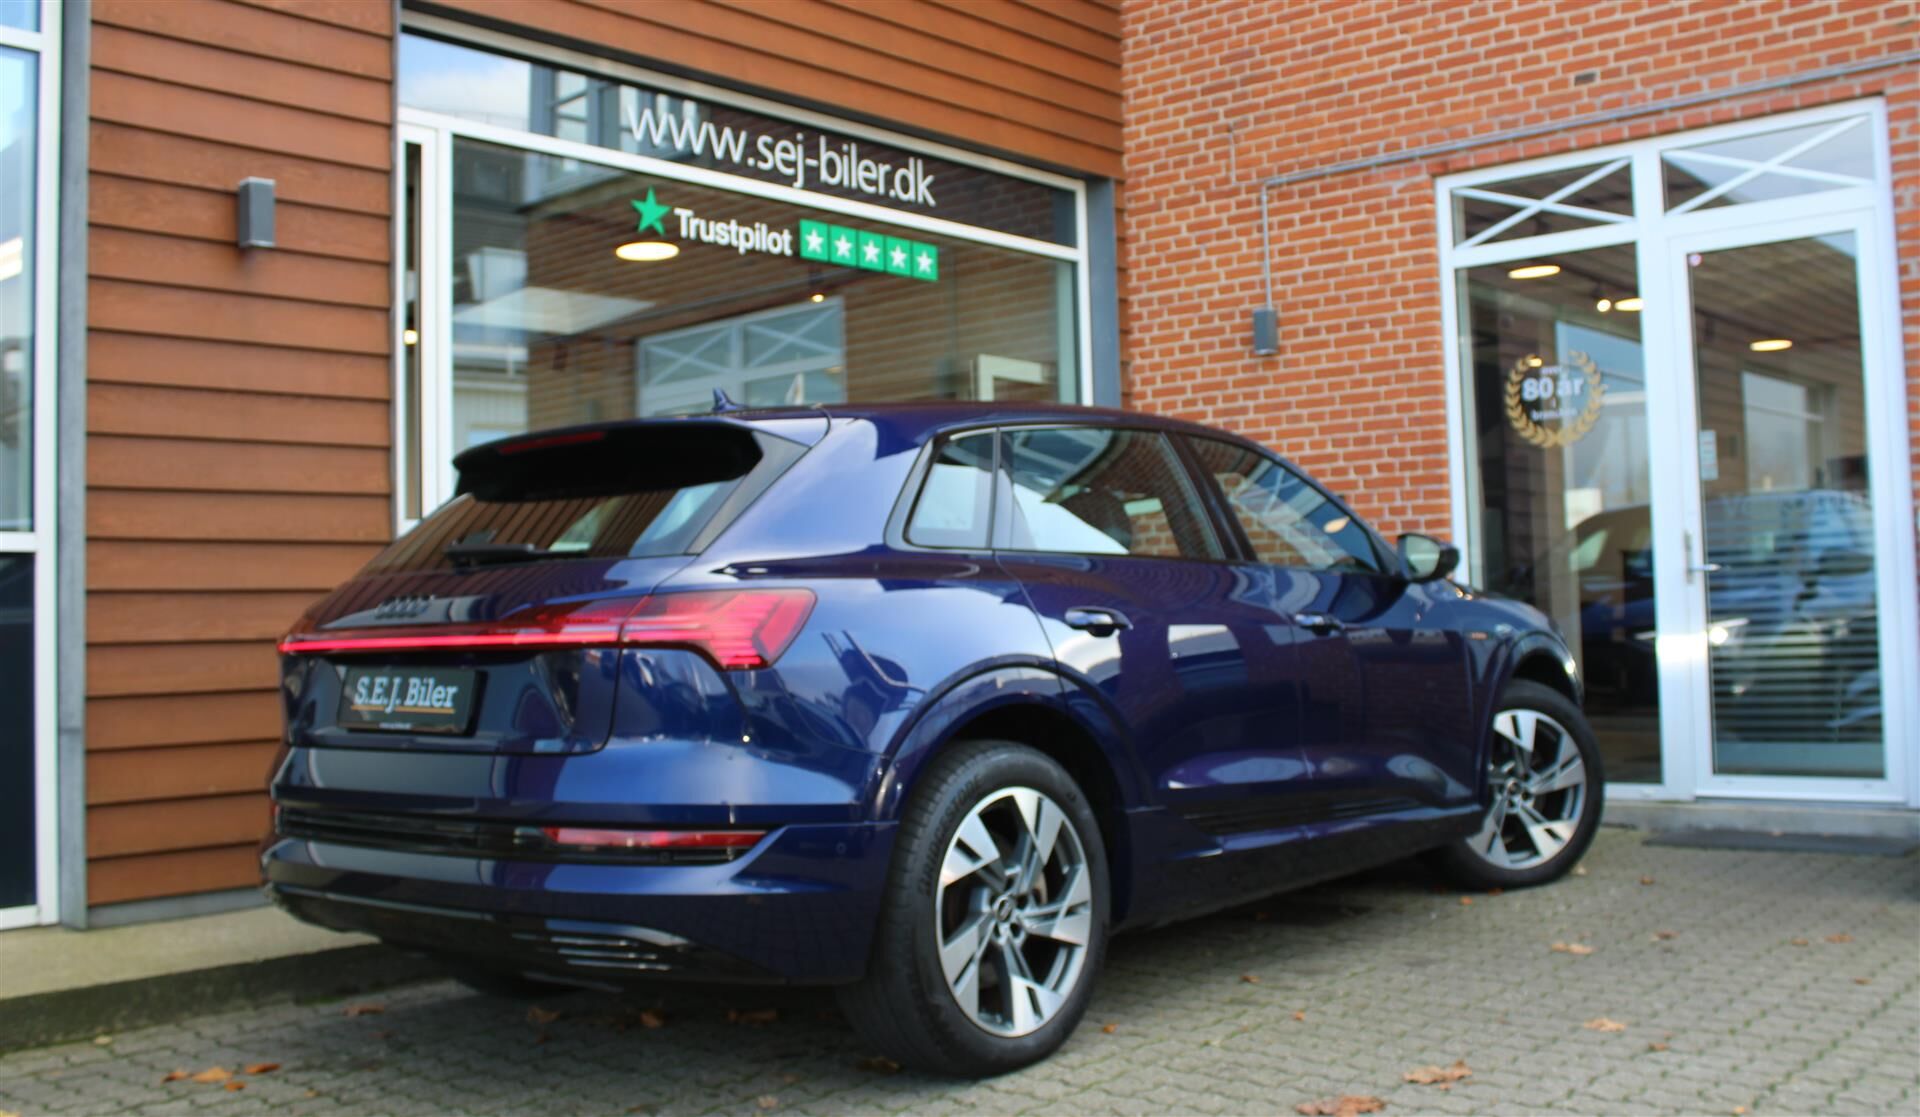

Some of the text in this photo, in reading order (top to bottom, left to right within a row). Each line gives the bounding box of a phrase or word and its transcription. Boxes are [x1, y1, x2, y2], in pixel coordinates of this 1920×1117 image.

[626, 105, 937, 207] www.sej-biler.dk
[674, 207, 793, 256] Trustpilot
[1523, 378, 1554, 401] 80
[353, 676, 459, 713] S.E.J. Biler
